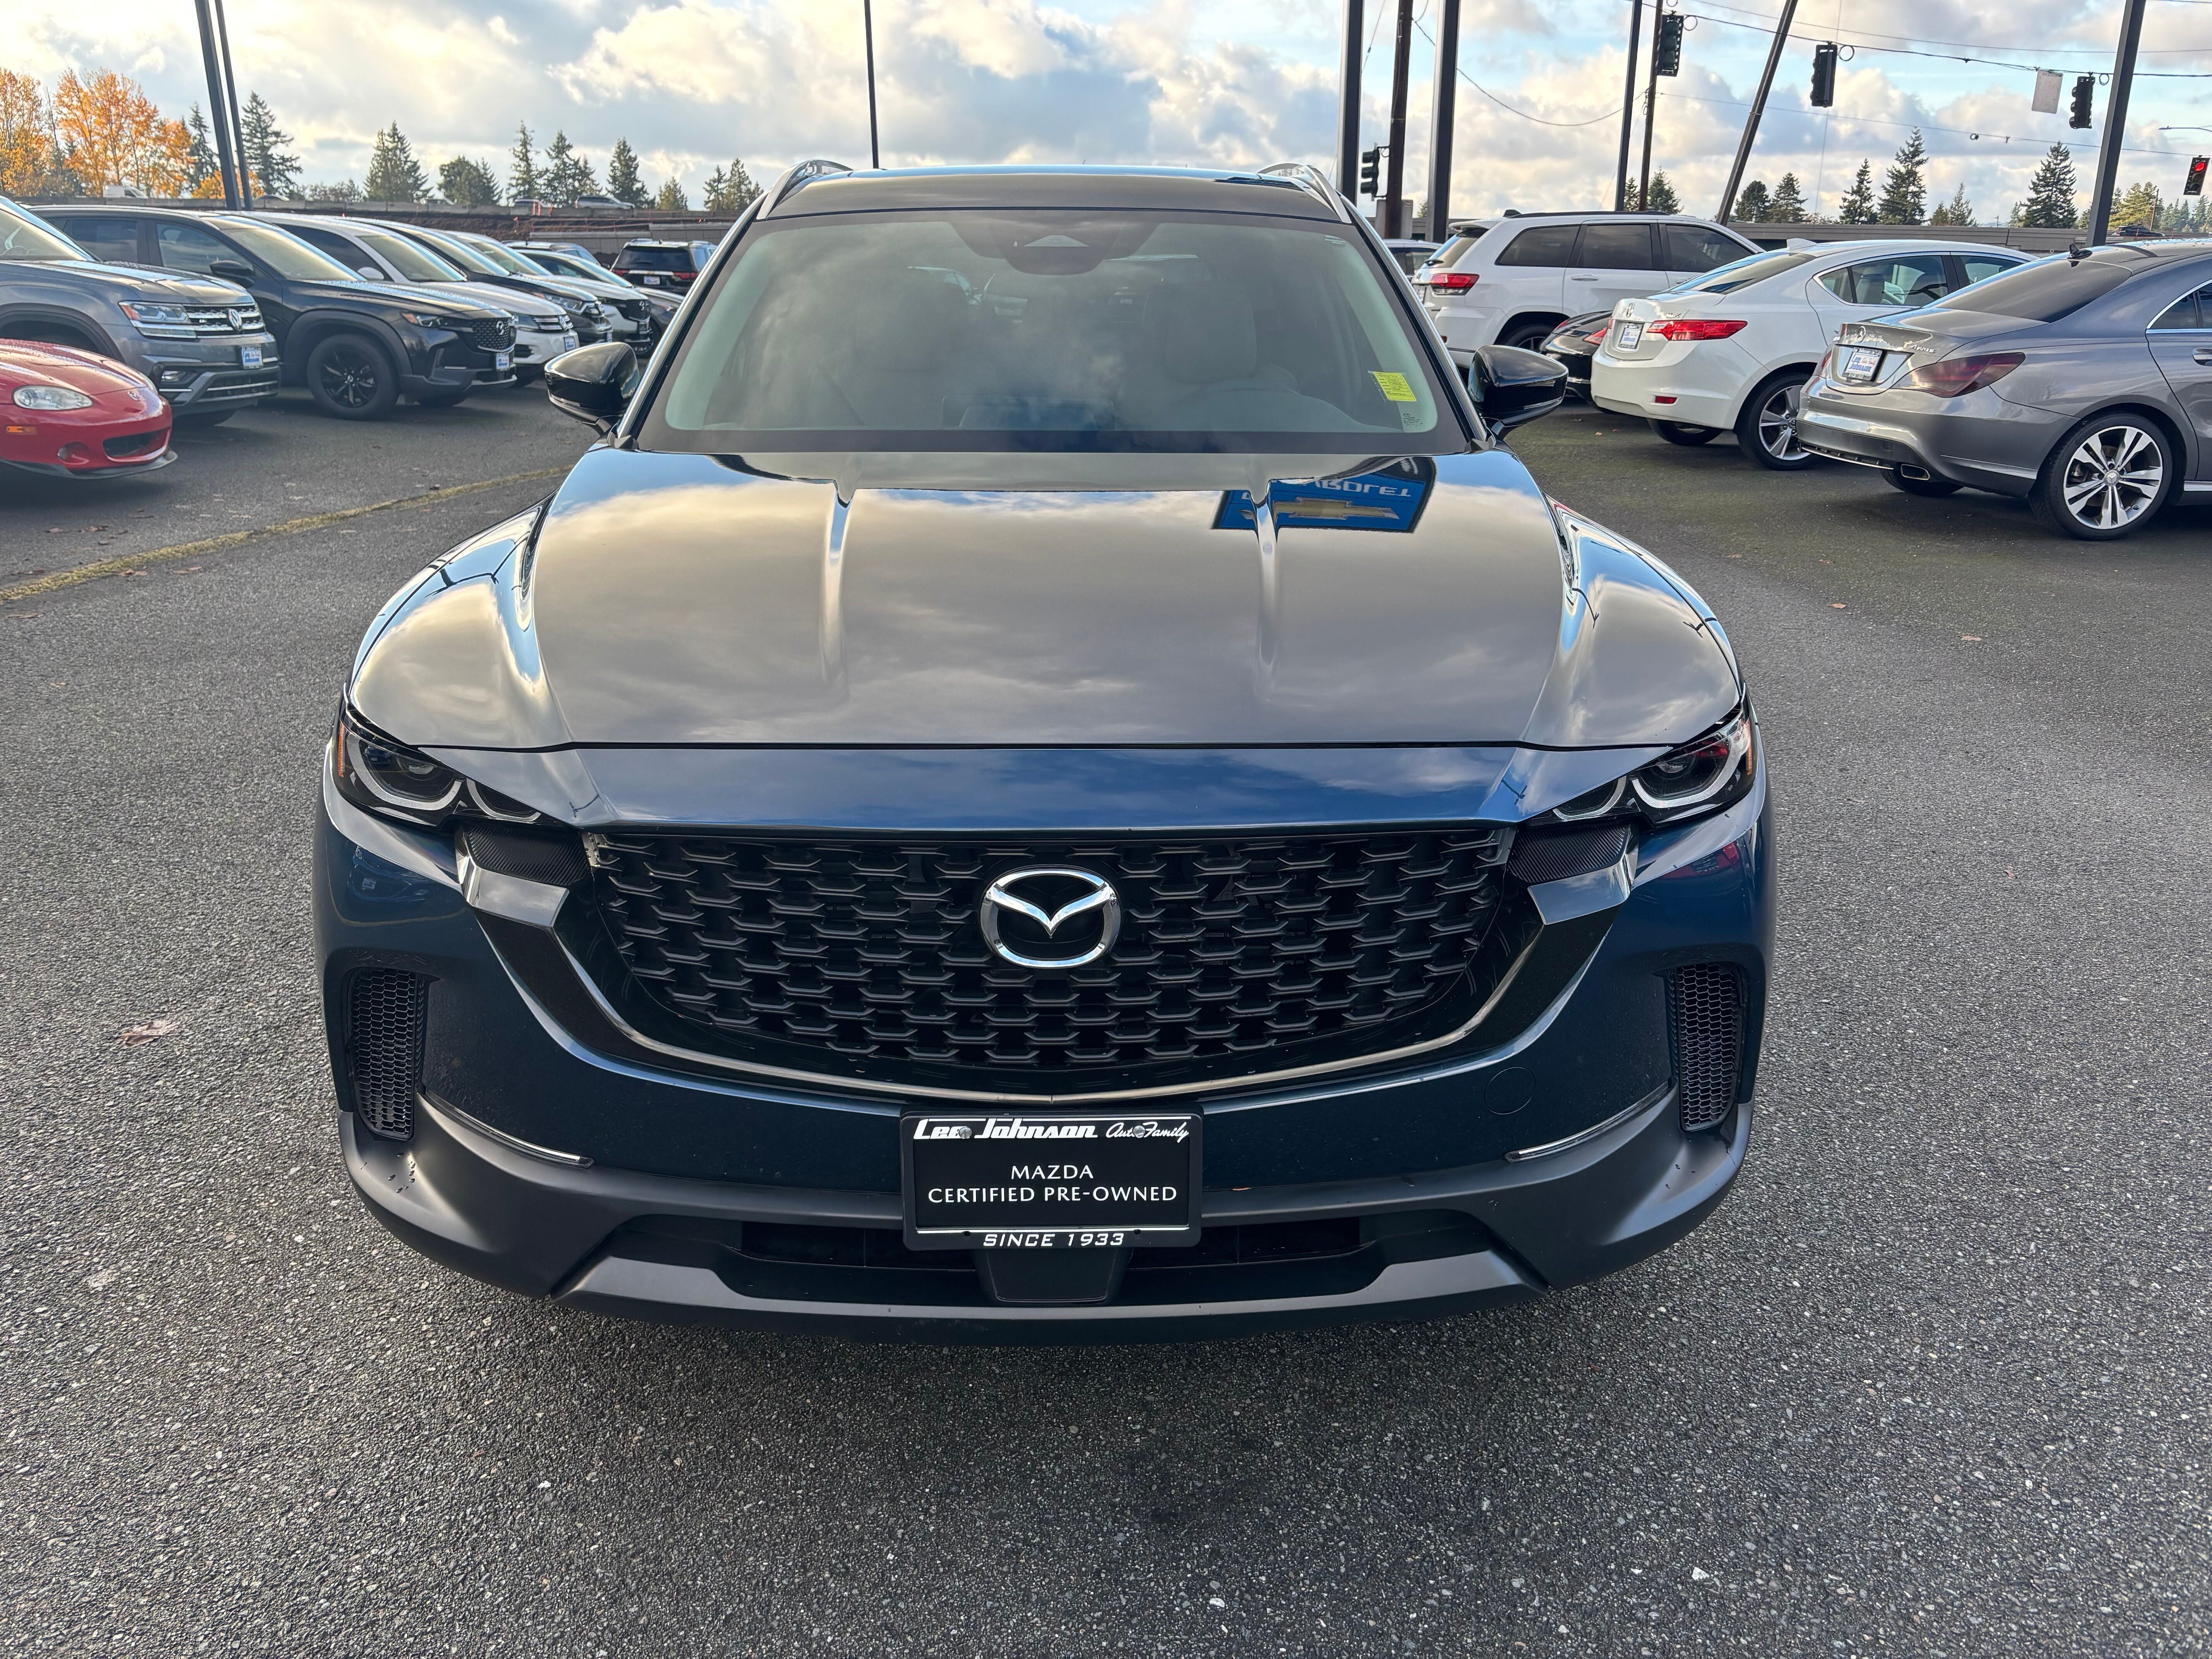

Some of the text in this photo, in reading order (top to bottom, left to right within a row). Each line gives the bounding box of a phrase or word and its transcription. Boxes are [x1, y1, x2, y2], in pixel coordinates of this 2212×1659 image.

[974, 1118, 1098, 1139] Johnson
[1106, 1122, 1139, 1138] Aut
[1142, 1121, 1189, 1143] Family
[1011, 1165, 1094, 1180] MAZDA
[928, 1187, 1177, 1203] CERTIFIED PRE-OWNED
[983, 1233, 1125, 1247] SINCE 1933
